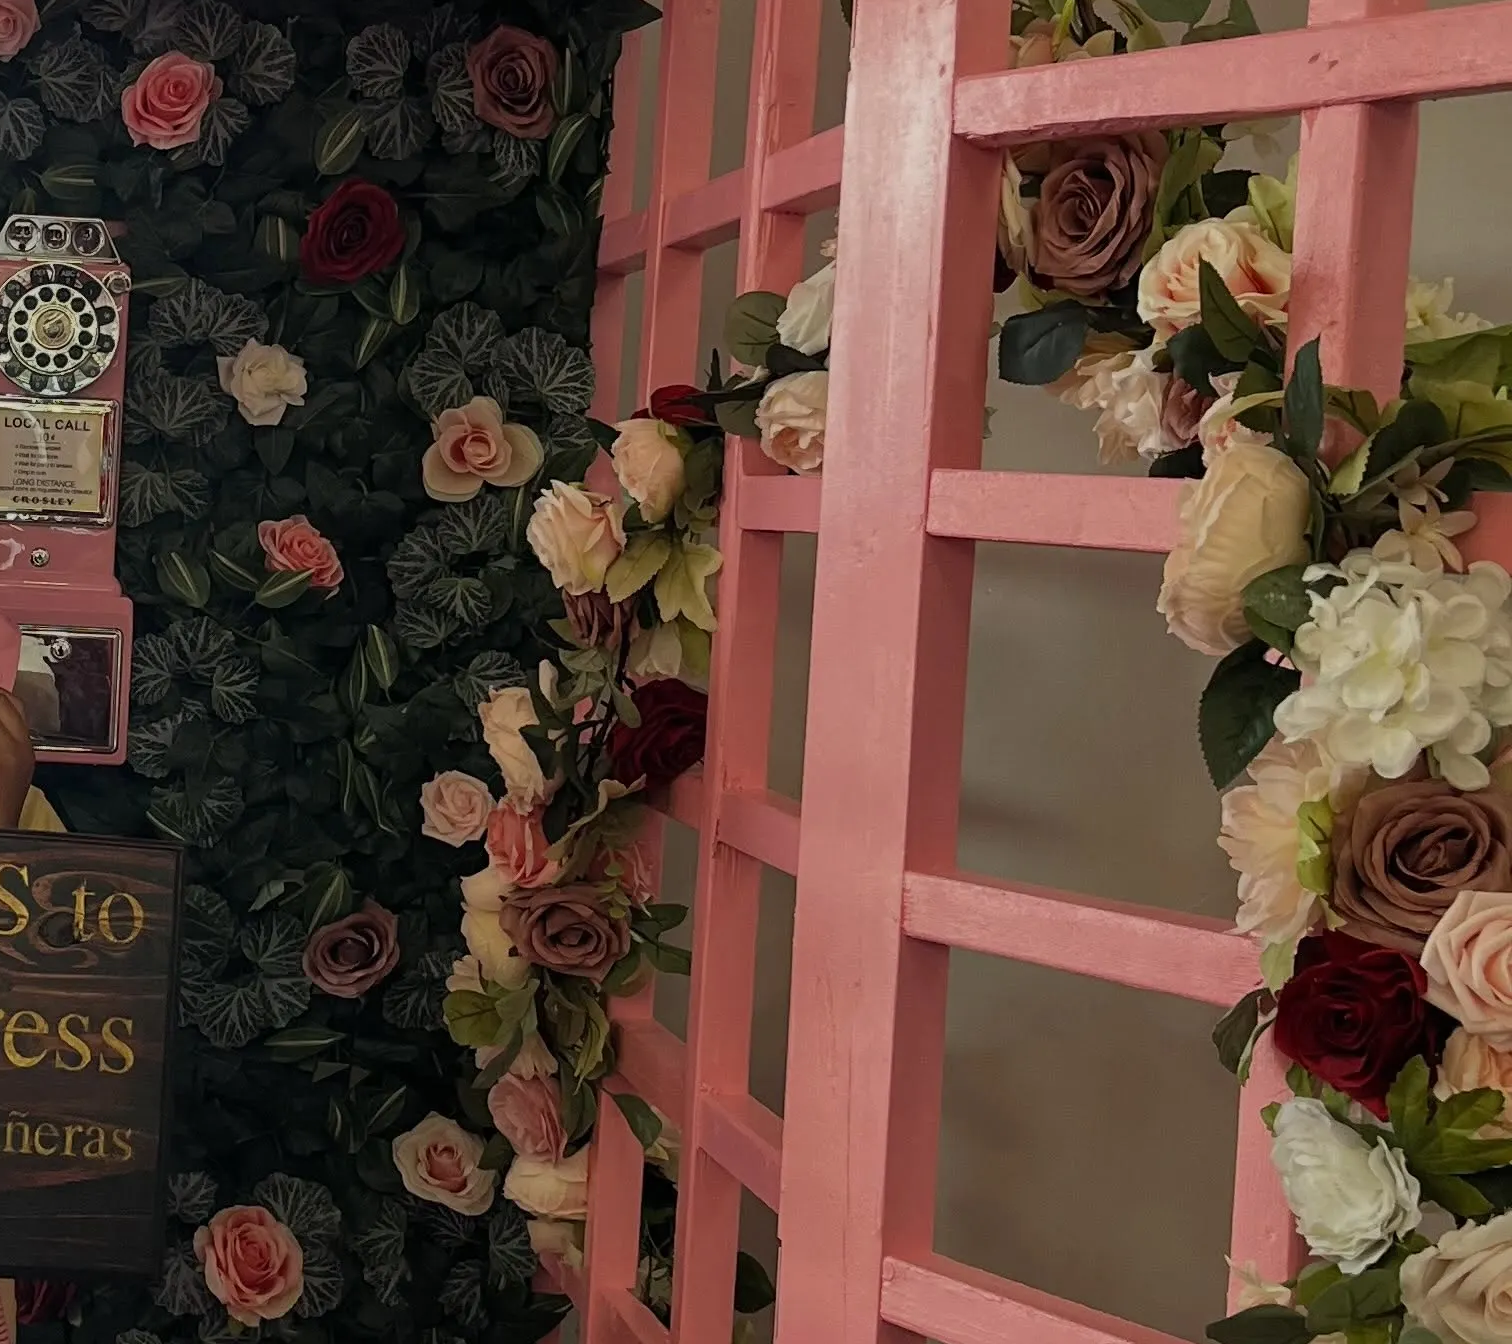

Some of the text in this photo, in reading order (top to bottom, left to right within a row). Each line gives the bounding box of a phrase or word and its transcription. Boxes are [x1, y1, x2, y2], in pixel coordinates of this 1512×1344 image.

[4, 417, 91, 432] LOCAL CALL
[12, 478, 76, 489] LONG DISTANCE
[12, 495, 74, 506] CROSLEY
[71, 879, 145, 945] to
